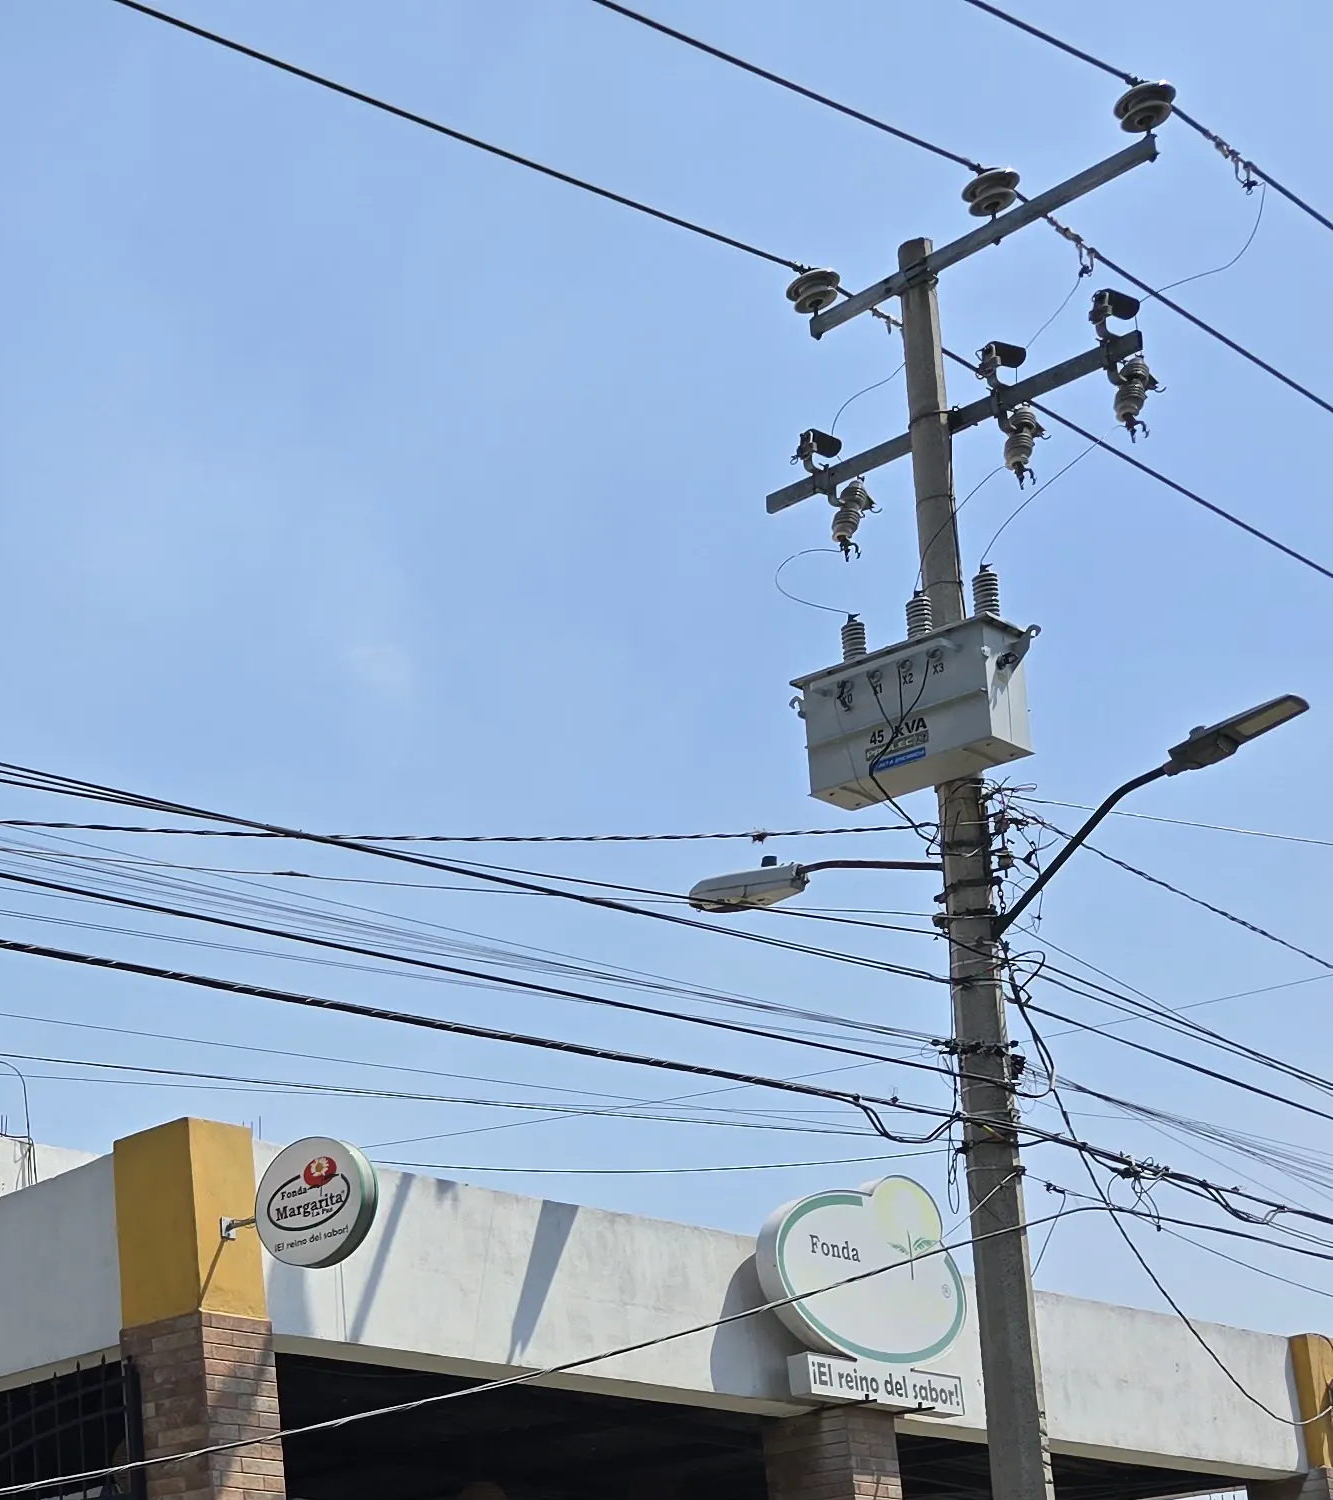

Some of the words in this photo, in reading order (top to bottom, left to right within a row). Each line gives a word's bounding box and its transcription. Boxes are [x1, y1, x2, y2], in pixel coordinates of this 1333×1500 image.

[933, 662, 944, 675] X3
[902, 673, 913, 685] X2
[873, 684, 883, 695] X1
[870, 729, 884, 744] 45
[866, 739, 913, 759] PRLEC
[281, 1186, 308, 1200] Fonda
[276, 1193, 344, 1221] Margarita
[287, 1238, 307, 1249] reino
[309, 1232, 322, 1243] del
[324, 1224, 348, 1239] sabor!
[809, 1234, 861, 1262] Fonda
[812, 1361, 834, 1387] ¡El
[838, 1369, 879, 1394] reino
[884, 1373, 908, 1399] del
[912, 1380, 960, 1407] sabor!
